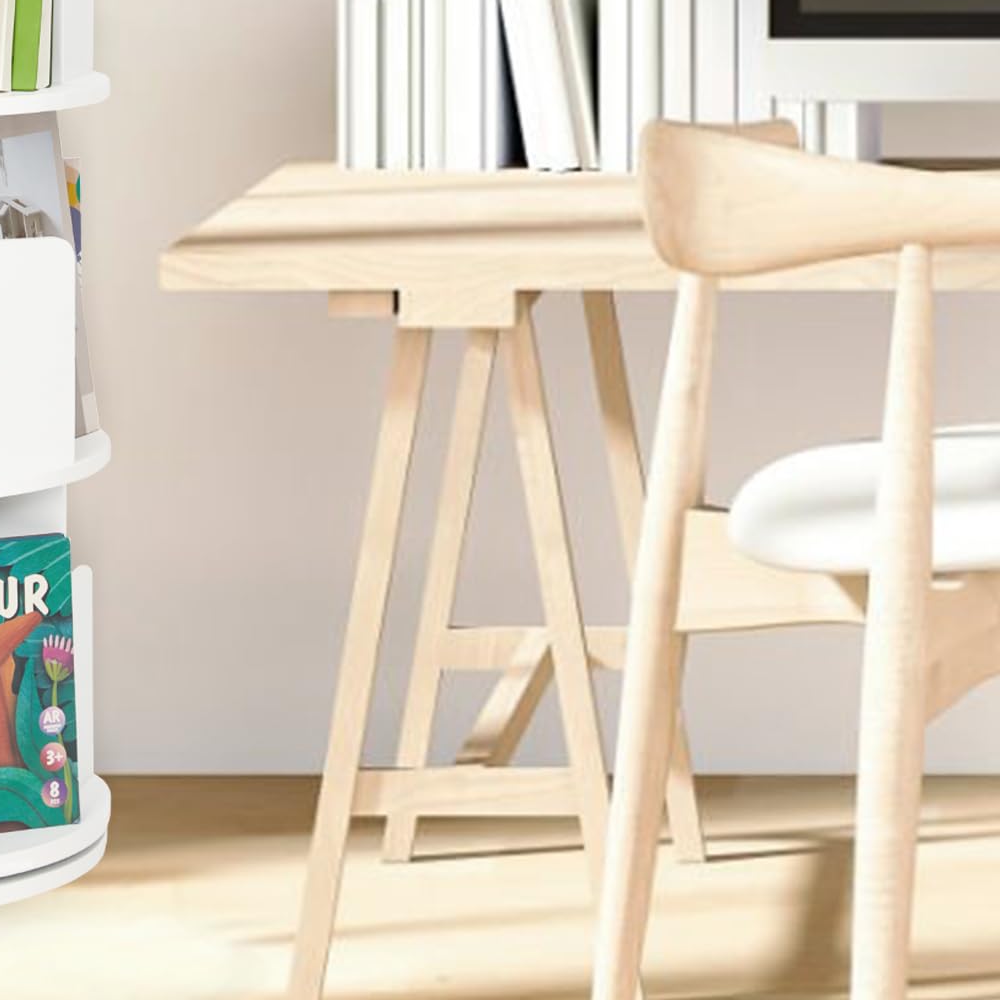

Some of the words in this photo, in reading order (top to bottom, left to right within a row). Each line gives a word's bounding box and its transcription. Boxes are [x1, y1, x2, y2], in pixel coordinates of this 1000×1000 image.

[42, 710, 60, 725] AR
[46, 749, 64, 766] 3+
[49, 780, 60, 798] 8
